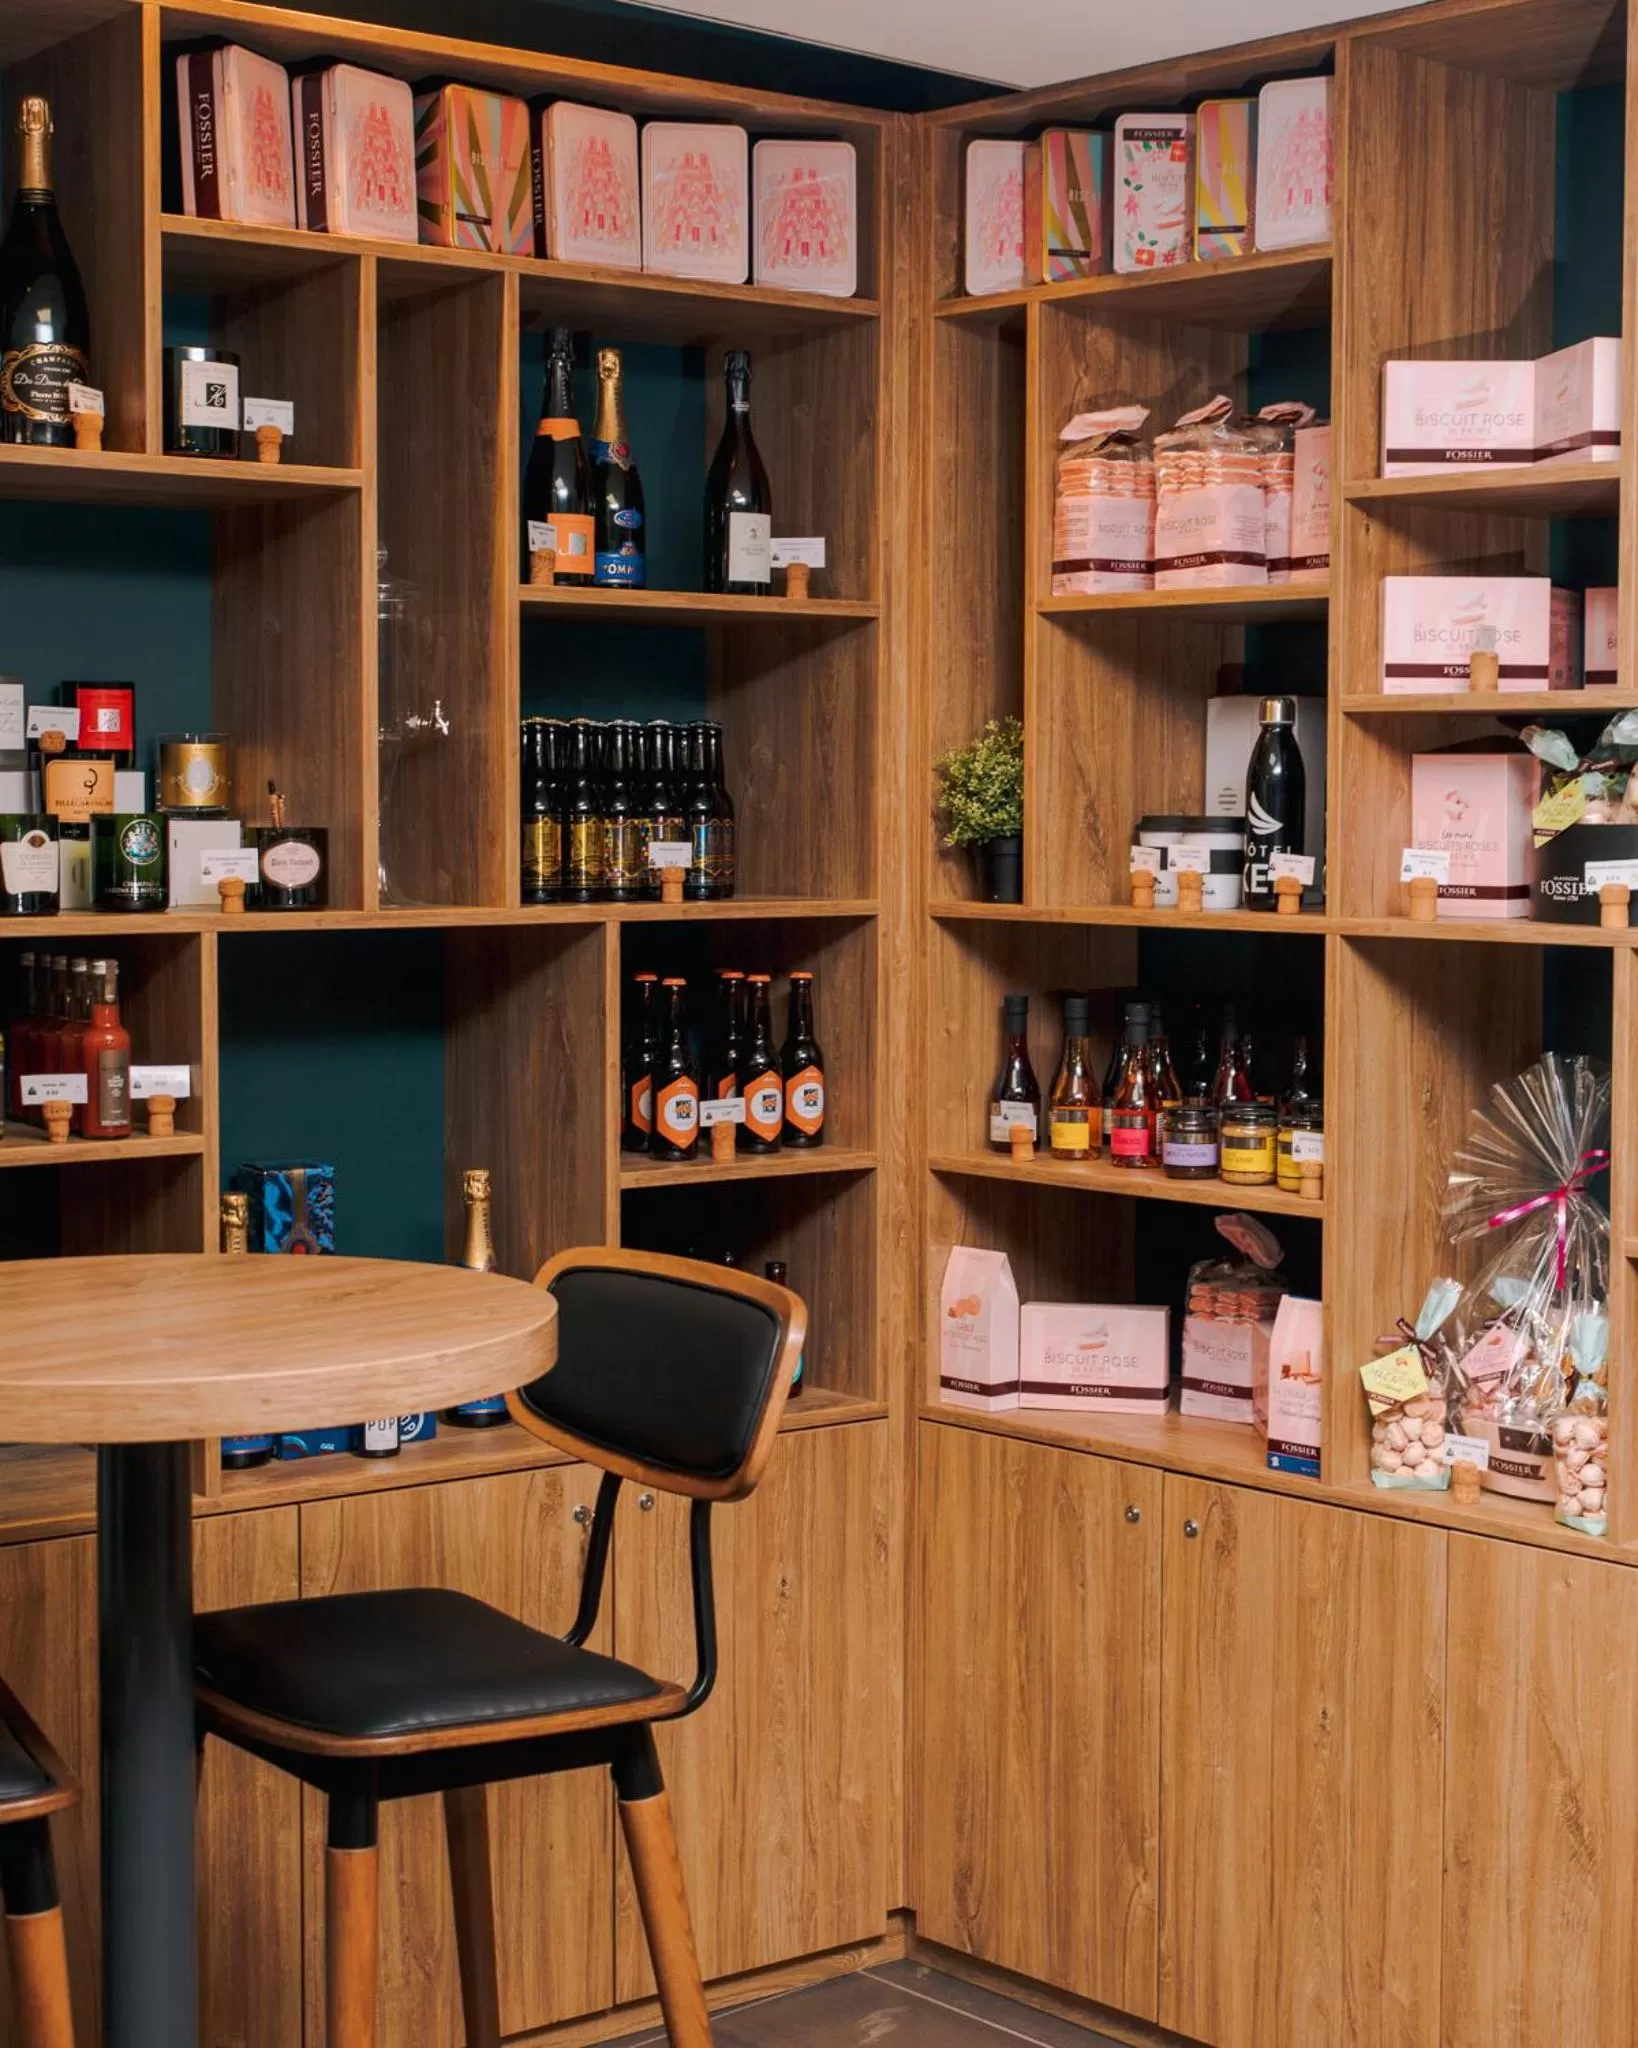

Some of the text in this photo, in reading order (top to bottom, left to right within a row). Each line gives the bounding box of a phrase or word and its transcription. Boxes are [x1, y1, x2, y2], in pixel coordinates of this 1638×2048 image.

[198, 92, 214, 180] FOSSIER
[309, 112, 322, 197] FOSSIER
[1483, 412, 1525, 427] ROSE
[1445, 450, 1493, 461] FOSSIER
[1442, 664, 1472, 676] FOSS
[1439, 886, 1477, 897] FOSSIER
[1540, 880, 1594, 896] FOSSIE
[1043, 1351, 1139, 1369] BISCUIT ROSE
[1069, 1384, 1112, 1396] FOSSIER
[1281, 1442, 1318, 1457] FOSSIER
[1490, 1459, 1533, 1475] FOSSIER
